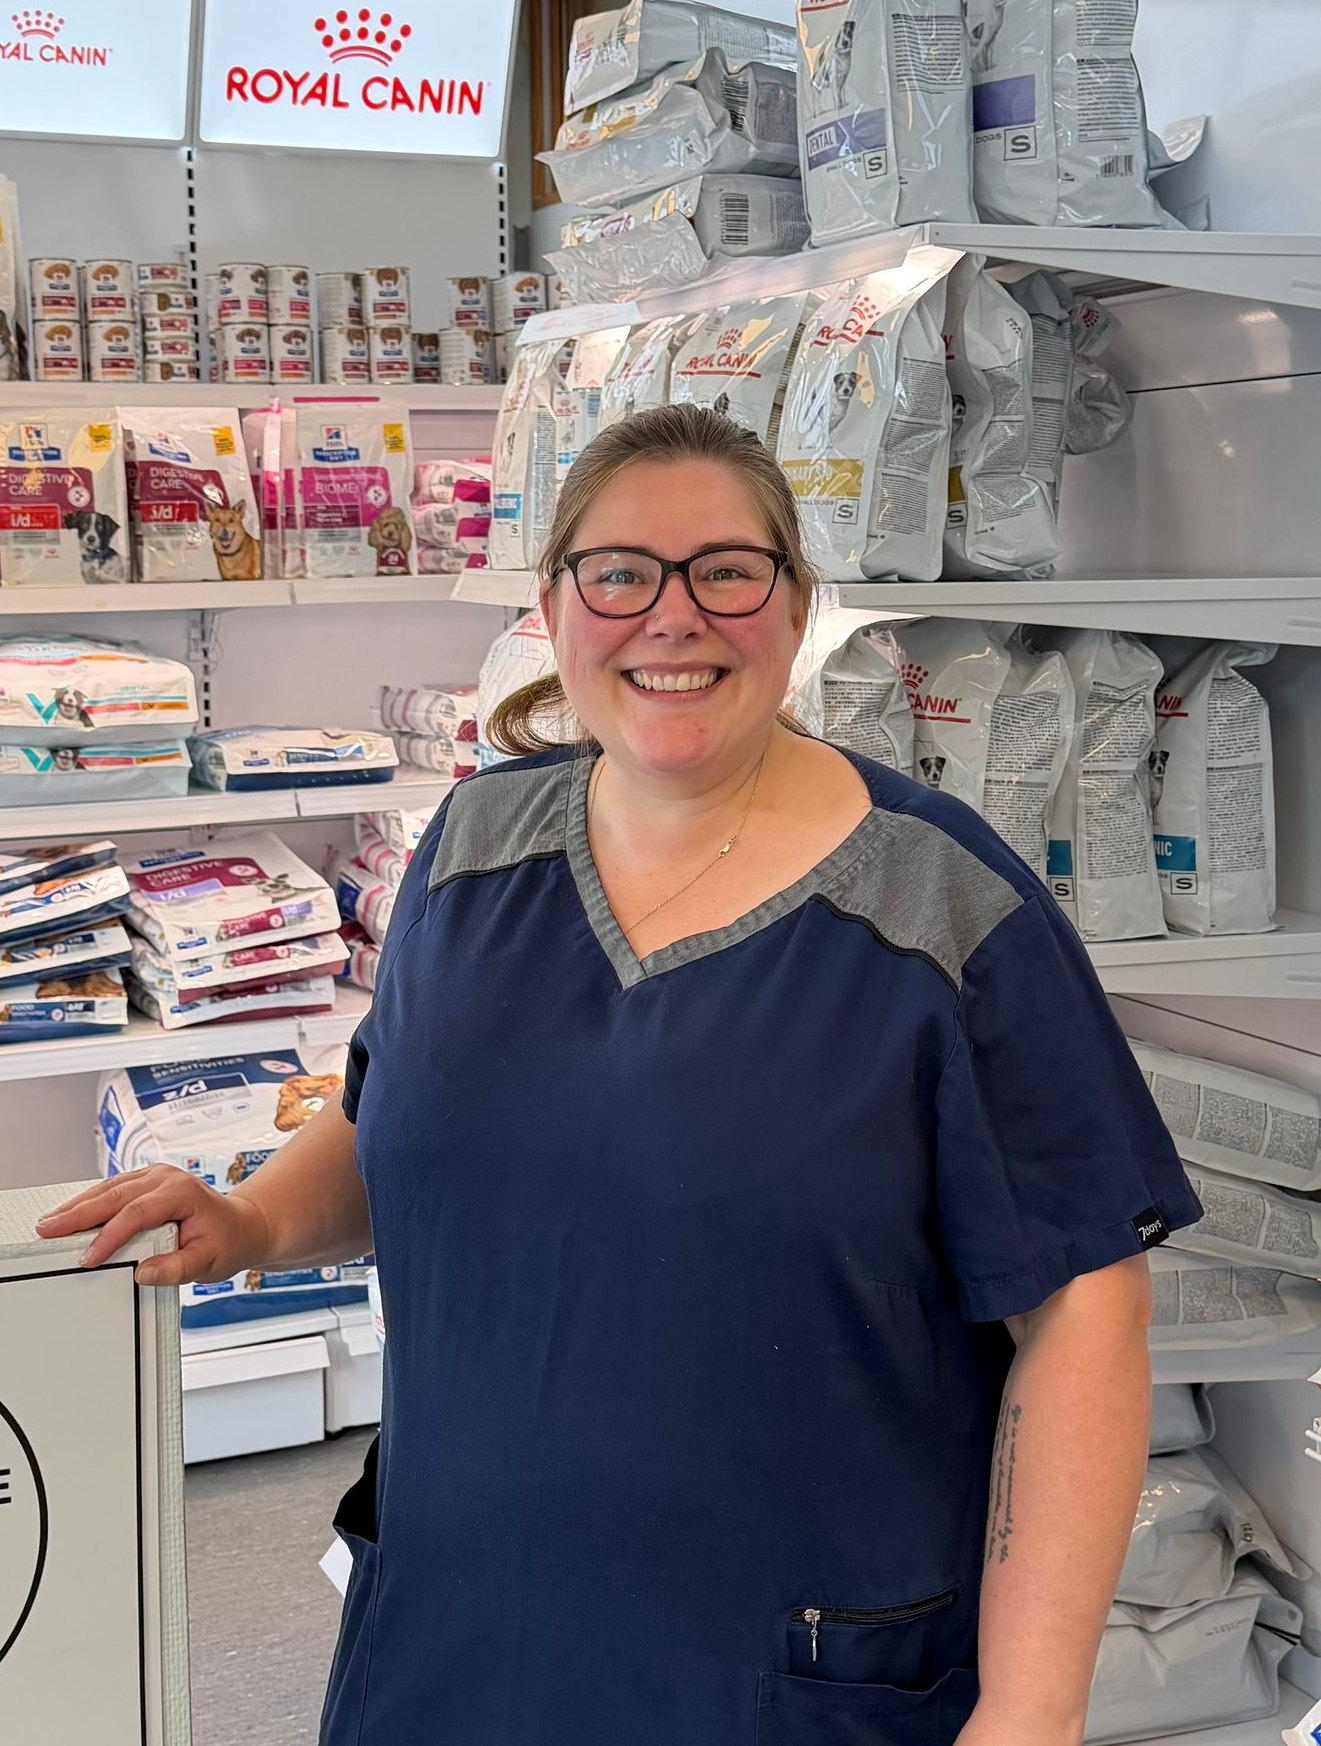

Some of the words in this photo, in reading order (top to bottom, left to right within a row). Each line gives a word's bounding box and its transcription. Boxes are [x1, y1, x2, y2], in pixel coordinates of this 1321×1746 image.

[39, 44, 107, 66] CANIN
[226, 66, 349, 108] ROYAL
[361, 76, 483, 115] CANIN
[808, 130, 834, 156] DENTAL
[975, 132, 1002, 145] DOGS
[1010, 134, 1032, 154] S
[867, 156, 883, 172] S
[315, 482, 359, 494] BIOME
[837, 504, 854, 519] S
[949, 510, 964, 523] S
[10, 513, 31, 527] i/d
[145, 861, 224, 882] DIGESTIVE
[150, 874, 191, 888] CARE
[1175, 877, 1193, 890] S
[1054, 882, 1070, 897] S
[162, 1080, 208, 1101] z/d
[1137, 1219, 1162, 1242] 7days
